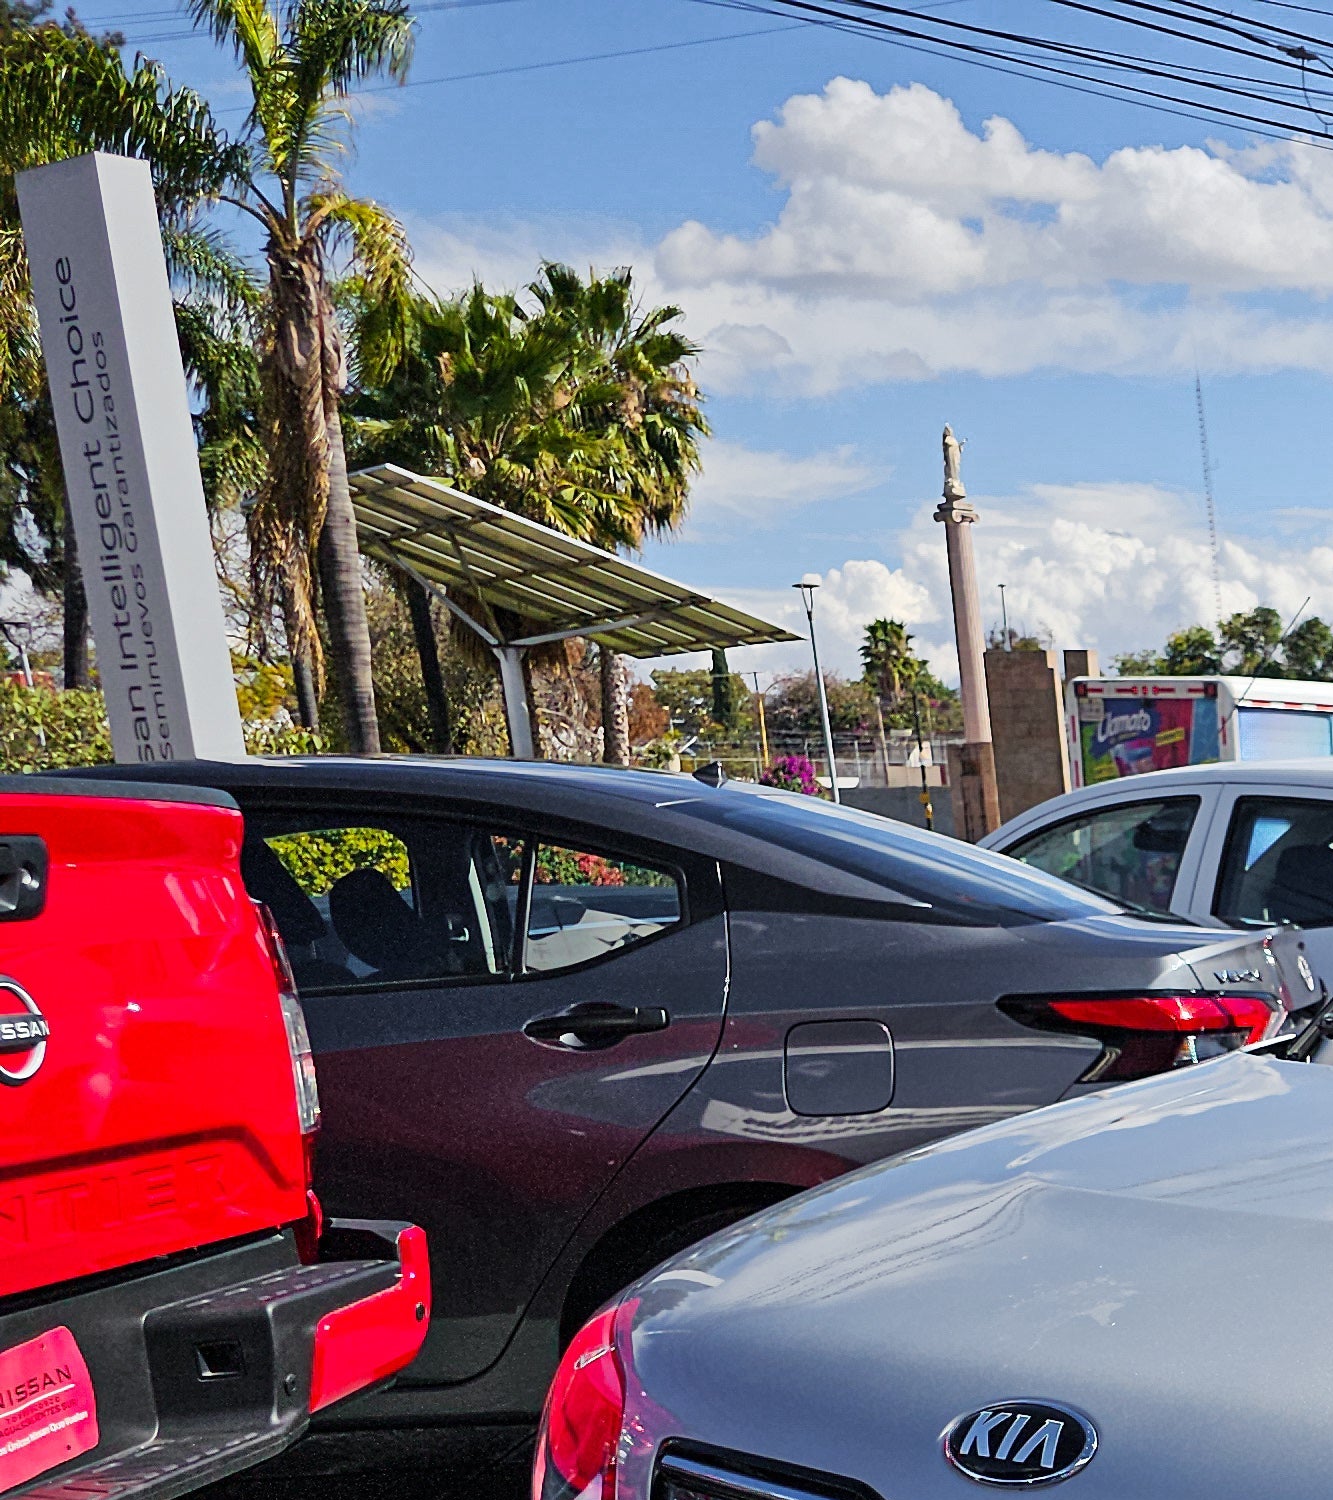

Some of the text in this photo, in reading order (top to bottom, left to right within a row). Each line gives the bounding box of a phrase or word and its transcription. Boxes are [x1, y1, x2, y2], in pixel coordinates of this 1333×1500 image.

[55, 256, 95, 425] Choice
[91, 331, 139, 553] Garantizados
[84, 439, 139, 670] Intelligent
[959, 1410, 1065, 1469] KIA
